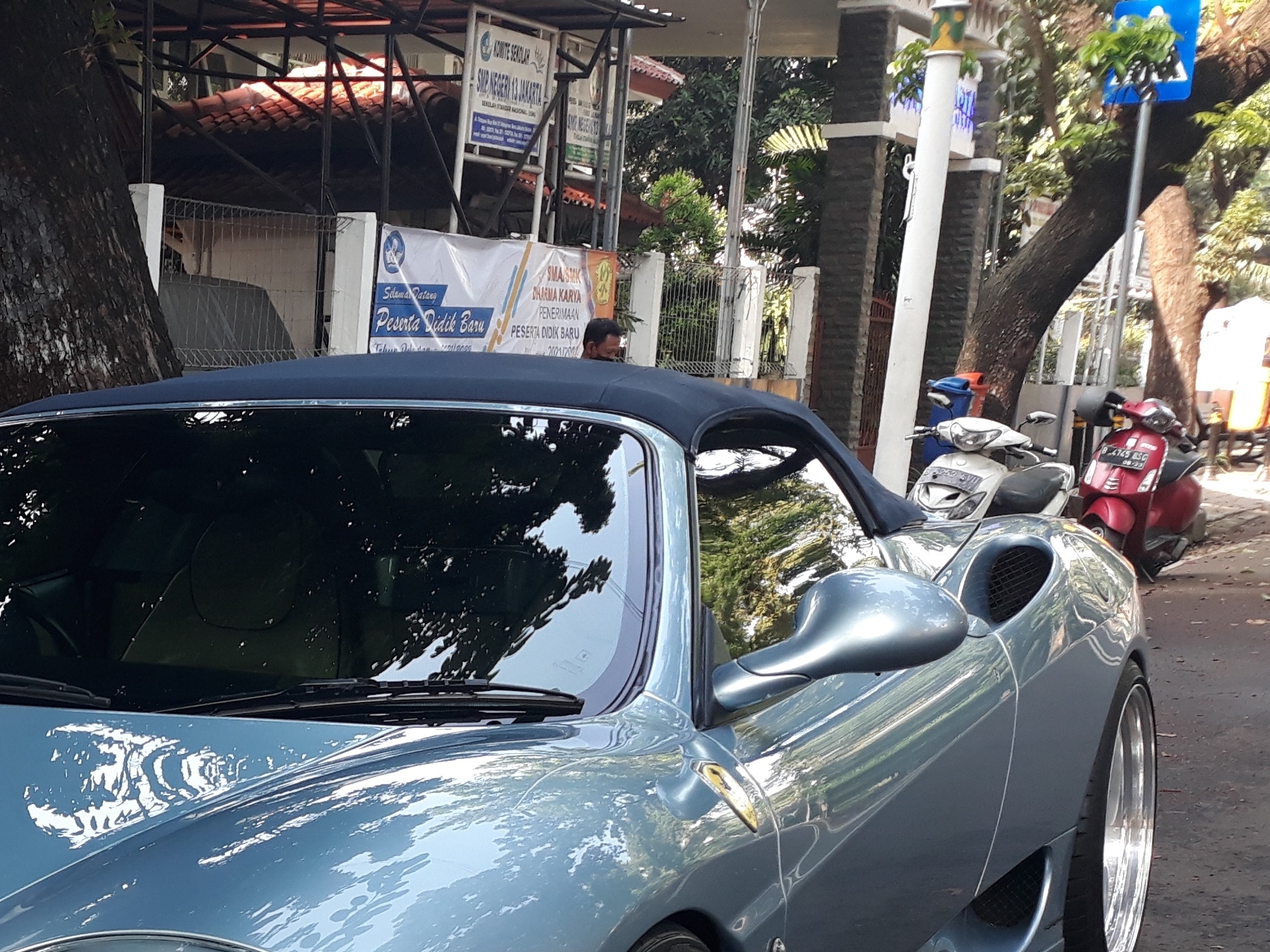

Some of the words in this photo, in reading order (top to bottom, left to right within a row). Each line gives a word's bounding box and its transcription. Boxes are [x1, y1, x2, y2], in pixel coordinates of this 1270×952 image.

[477, 68, 490, 94] SMP
[489, 72, 510, 100] NEGERI
[518, 78, 543, 107] JAKARTA
[412, 286, 437, 304] Datang
[533, 287, 558, 302] DHARMA
[559, 289, 581, 304] KARYA
[376, 307, 421, 333] Peserta
[423, 309, 457, 333] Didik
[459, 310, 485, 334] Baru
[540, 306, 579, 321] PENERIMAAN
[511, 325, 540, 340] PESERTA
[541, 327, 560, 340] DIDIK
[561, 327, 580, 340] BARU
